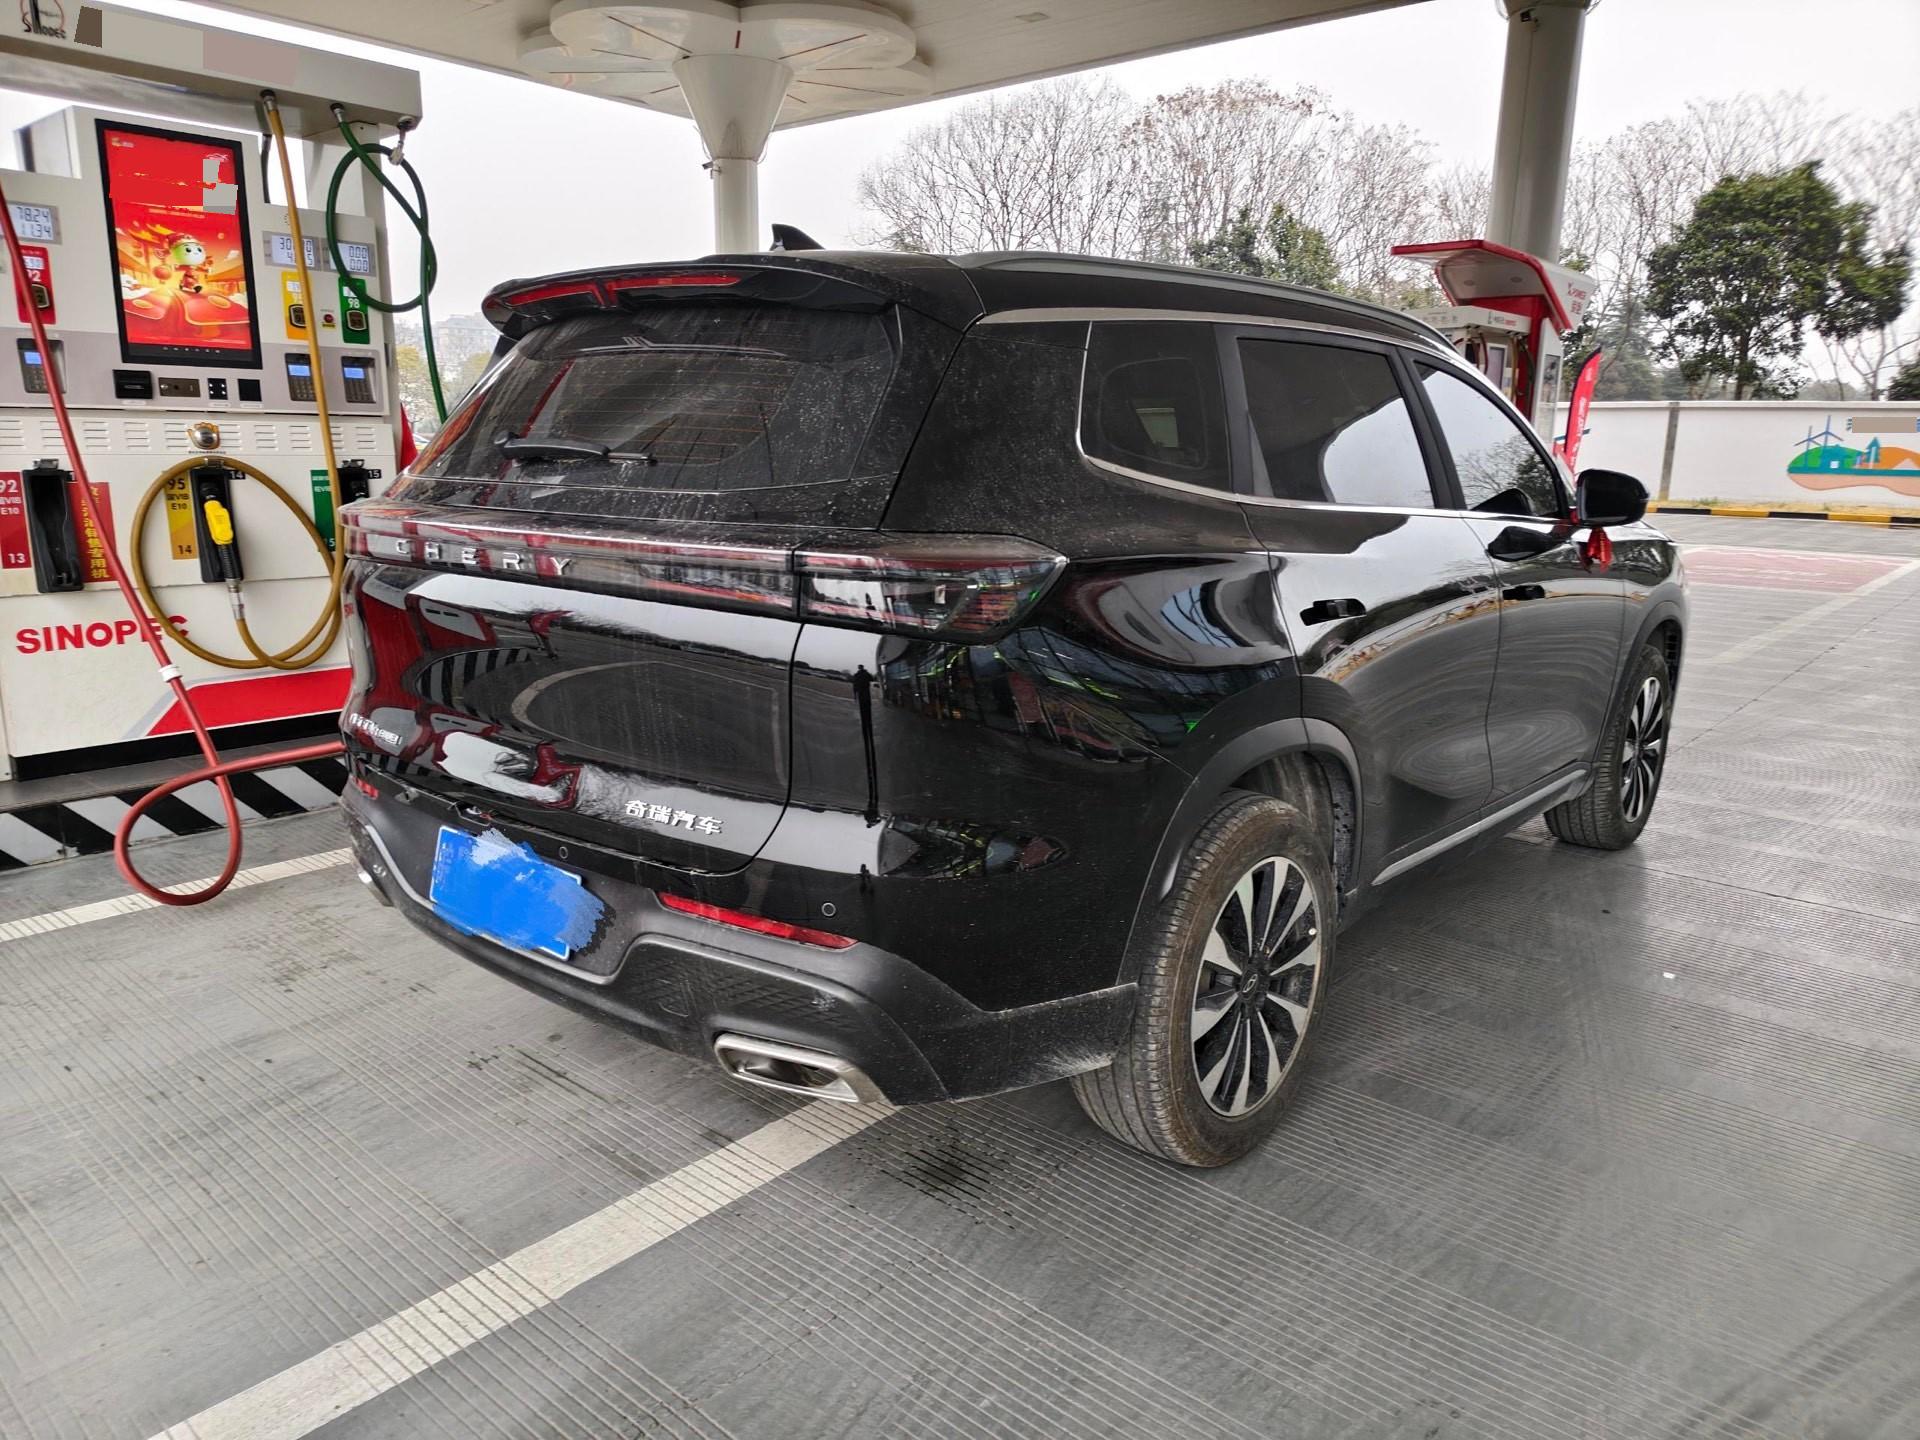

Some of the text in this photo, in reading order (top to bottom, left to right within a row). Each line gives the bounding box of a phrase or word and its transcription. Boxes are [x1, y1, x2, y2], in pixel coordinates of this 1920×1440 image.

[348, 298, 360, 308] 98
[230, 470, 244, 480] 14
[368, 469, 380, 478] 15
[167, 478, 186, 491] 95
[171, 502, 188, 510] E10
[177, 544, 193, 555] 14
[8, 552, 26, 564] 13
[395, 538, 571, 576] CHERY
[624, 799, 723, 835] 奇瑞汽车
